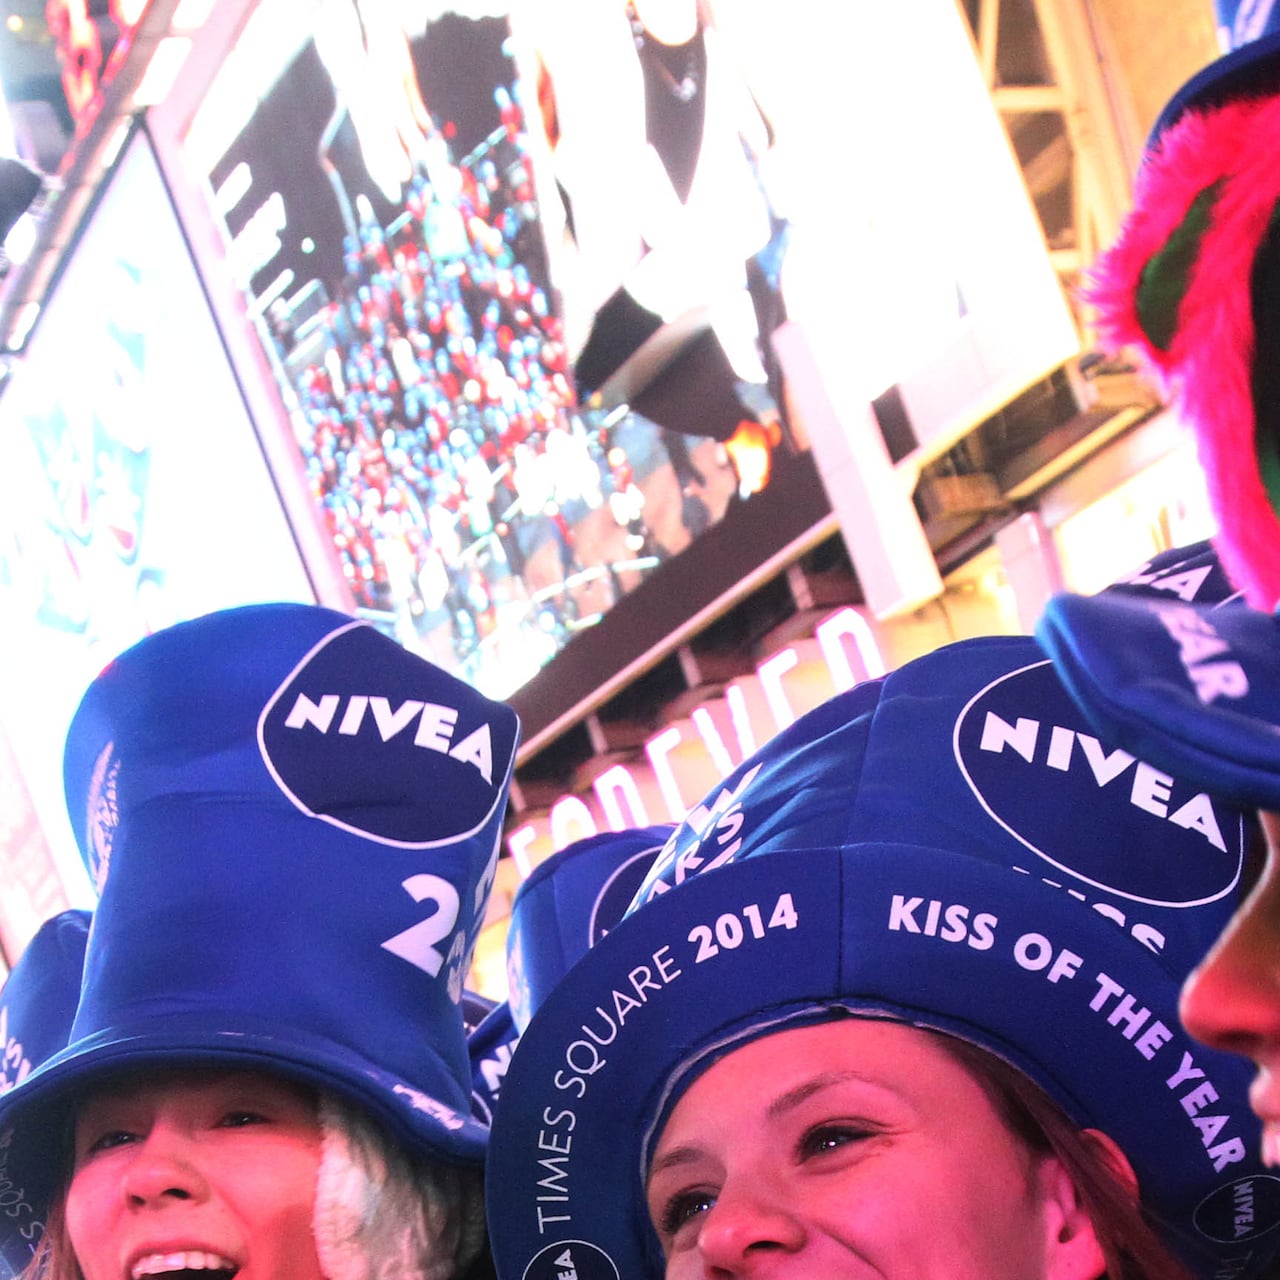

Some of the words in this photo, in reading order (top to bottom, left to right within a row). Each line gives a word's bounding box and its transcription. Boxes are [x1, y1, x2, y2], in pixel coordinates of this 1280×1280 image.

[284, 692, 494, 786] NIVEA
[979, 711, 1228, 854] NIVEA
[687, 893, 799, 965] 2014
[554, 944, 682, 1099] SQUARE
[887, 895, 999, 951] KISS
[1013, 932, 1084, 984] OF
[1088, 972, 1174, 1062] THE
[1165, 1052, 1247, 1174] YEAR
[535, 1106, 577, 1235] TIMES
[1232, 1180, 1255, 1239] NIVEA
